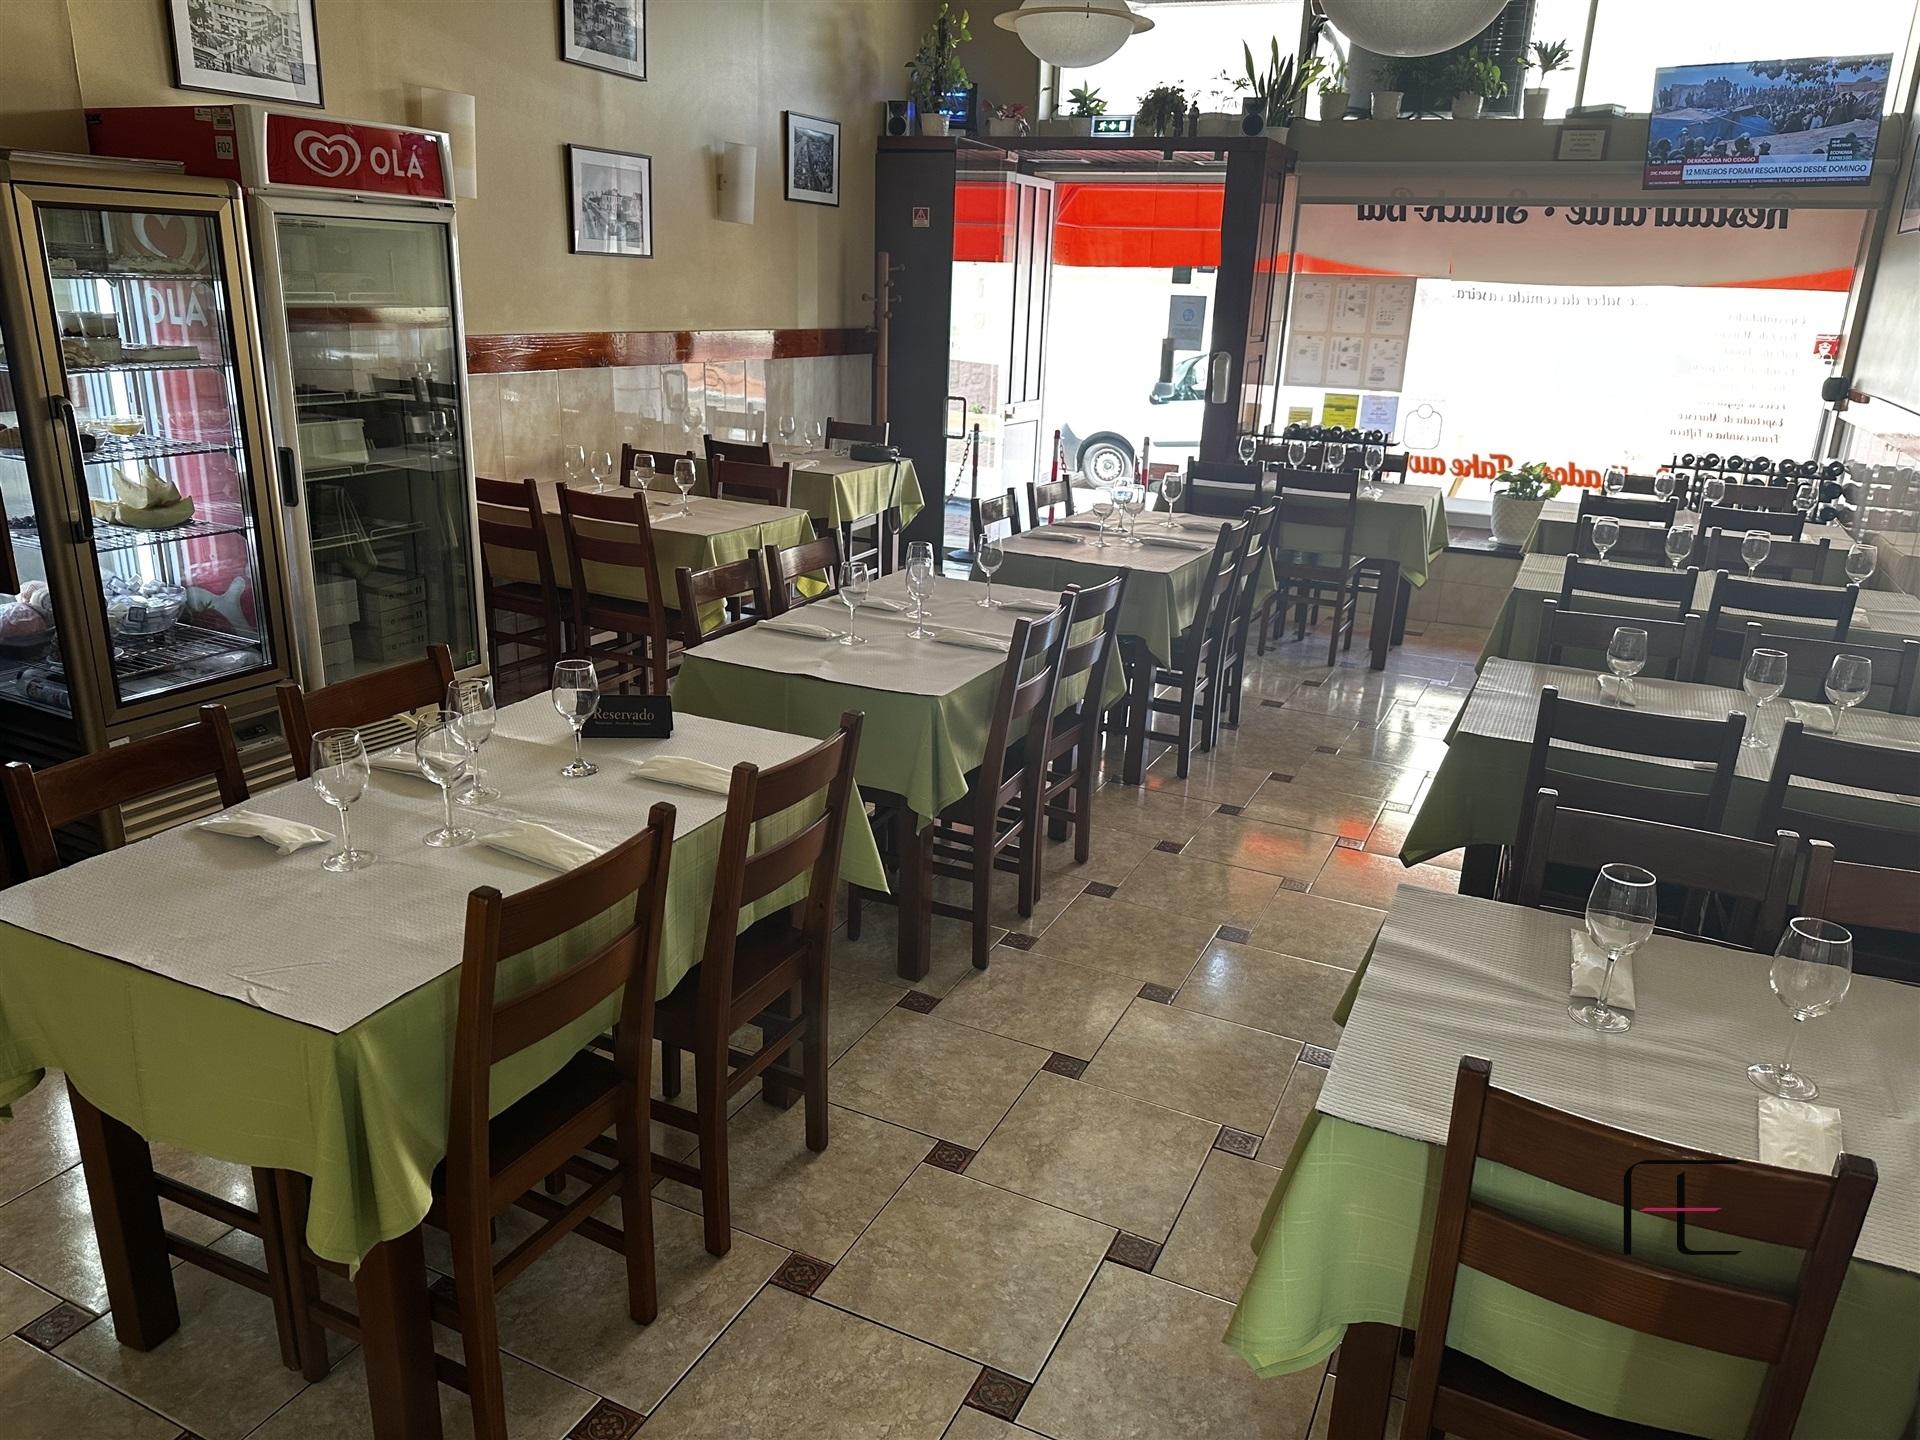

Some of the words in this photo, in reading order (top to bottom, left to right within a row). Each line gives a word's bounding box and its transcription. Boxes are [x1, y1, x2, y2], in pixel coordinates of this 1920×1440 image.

[369, 144, 425, 180] OLÁ
[1685, 168, 1693, 176] 12
[1693, 167, 1728, 176] MINEIROS
[1728, 166, 1754, 175] FORAM
[1754, 165, 1803, 174] RESGATADOS
[1803, 165, 1828, 173] DESDE
[1828, 164, 1867, 173] DOMINGO
[593, 707, 655, 721] Reservado
